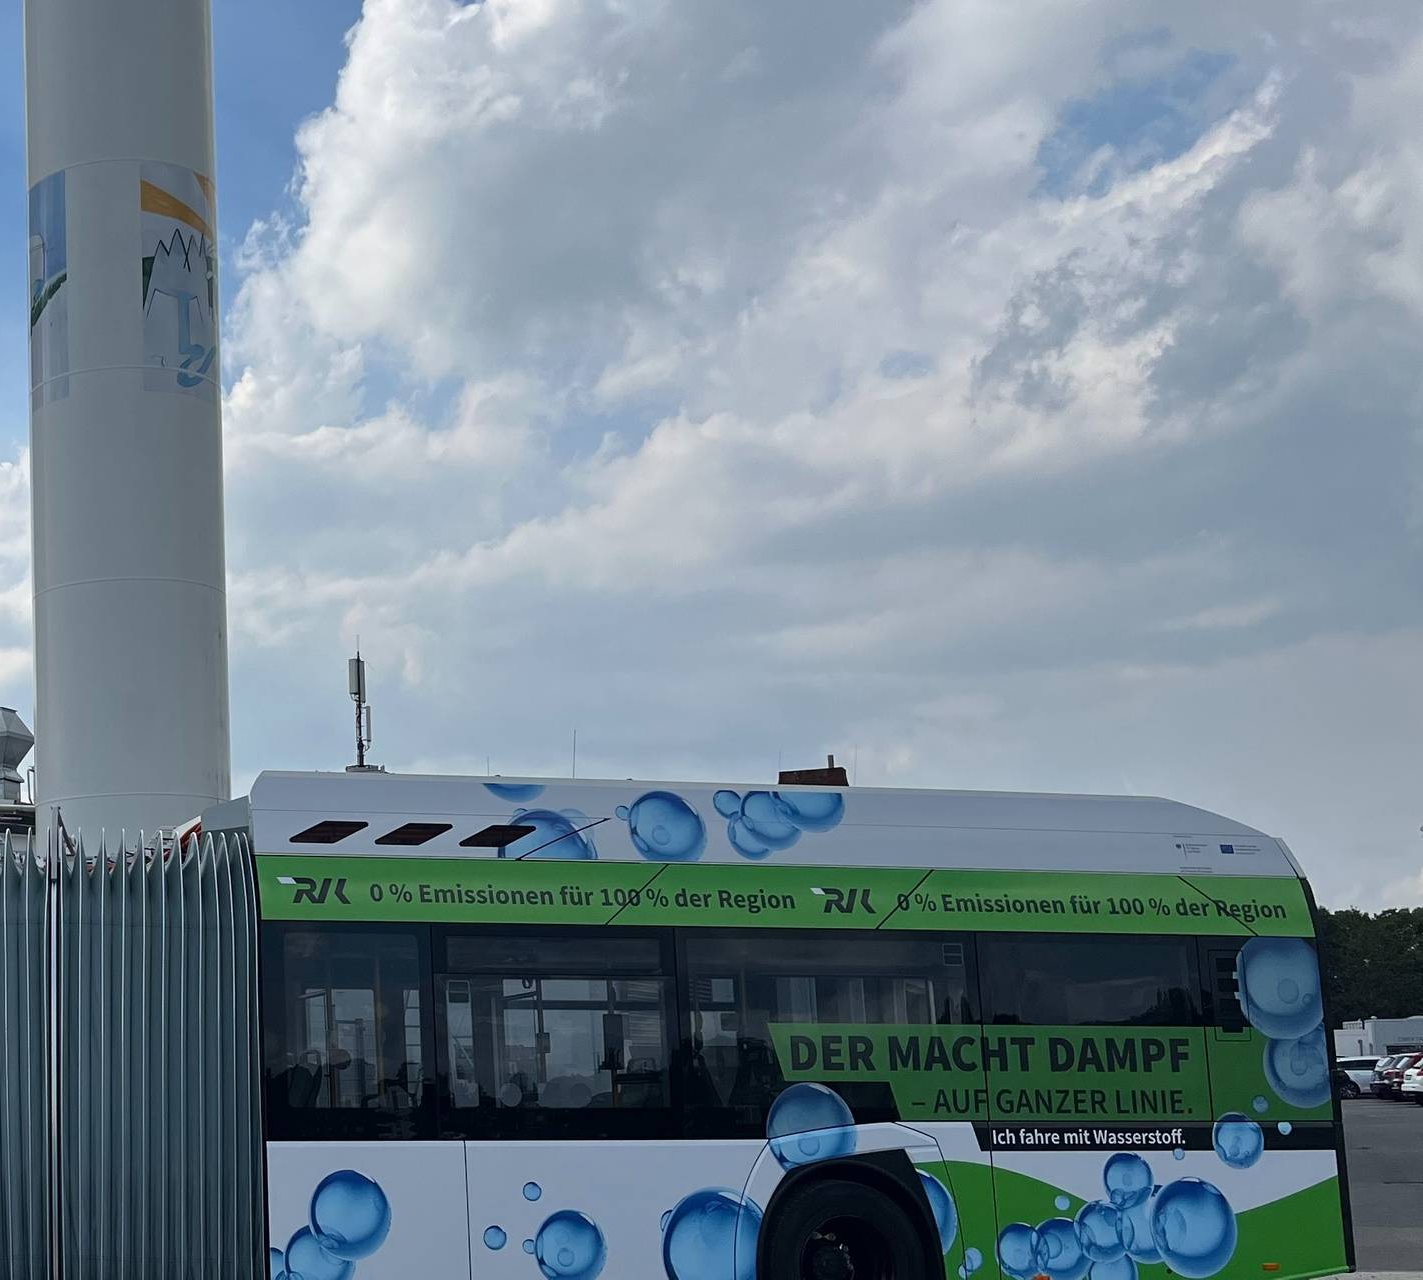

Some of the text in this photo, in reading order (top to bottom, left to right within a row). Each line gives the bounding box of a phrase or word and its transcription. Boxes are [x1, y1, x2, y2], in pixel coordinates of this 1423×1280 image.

[369, 883, 796, 914] 0 % Emissionen für 100 % der Region
[896, 893, 1287, 923] 0 % Emissionen für 100 % der Region
[790, 1035, 1190, 1073] DER MACHT DAMPF
[933, 1088, 988, 1115] AUF
[995, 1089, 1109, 1115] GANZER
[1116, 1090, 1194, 1115] LINIE.
[992, 1128, 1187, 1146] Ich fahre mit Wasserstoff.
